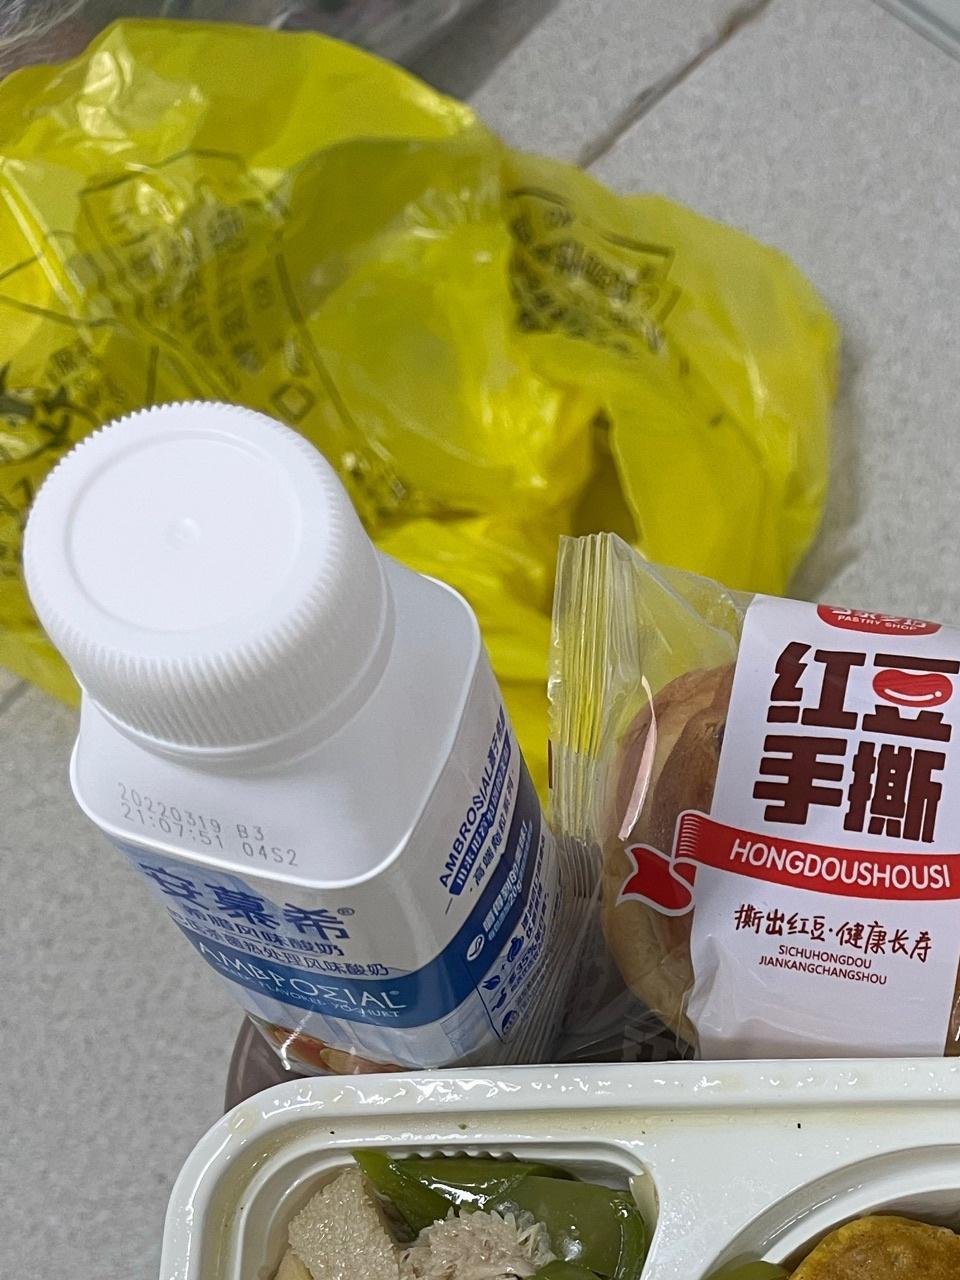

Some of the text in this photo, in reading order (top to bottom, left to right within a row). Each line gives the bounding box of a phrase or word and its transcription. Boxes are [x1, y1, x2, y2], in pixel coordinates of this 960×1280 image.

[836, 614, 918, 631] PASTRY SHOP
[766, 641, 960, 743] 红豆
[118, 782, 264, 842] 20220319 B3
[752, 734, 946, 843] 手撕
[120, 802, 223, 849] 21:07:51
[729, 838, 951, 889] HONGDOUSHOUSI
[759, 955, 887, 985] JIANKANGCHANGSHOU
[778, 944, 872, 969] SICHUHONGDOU
